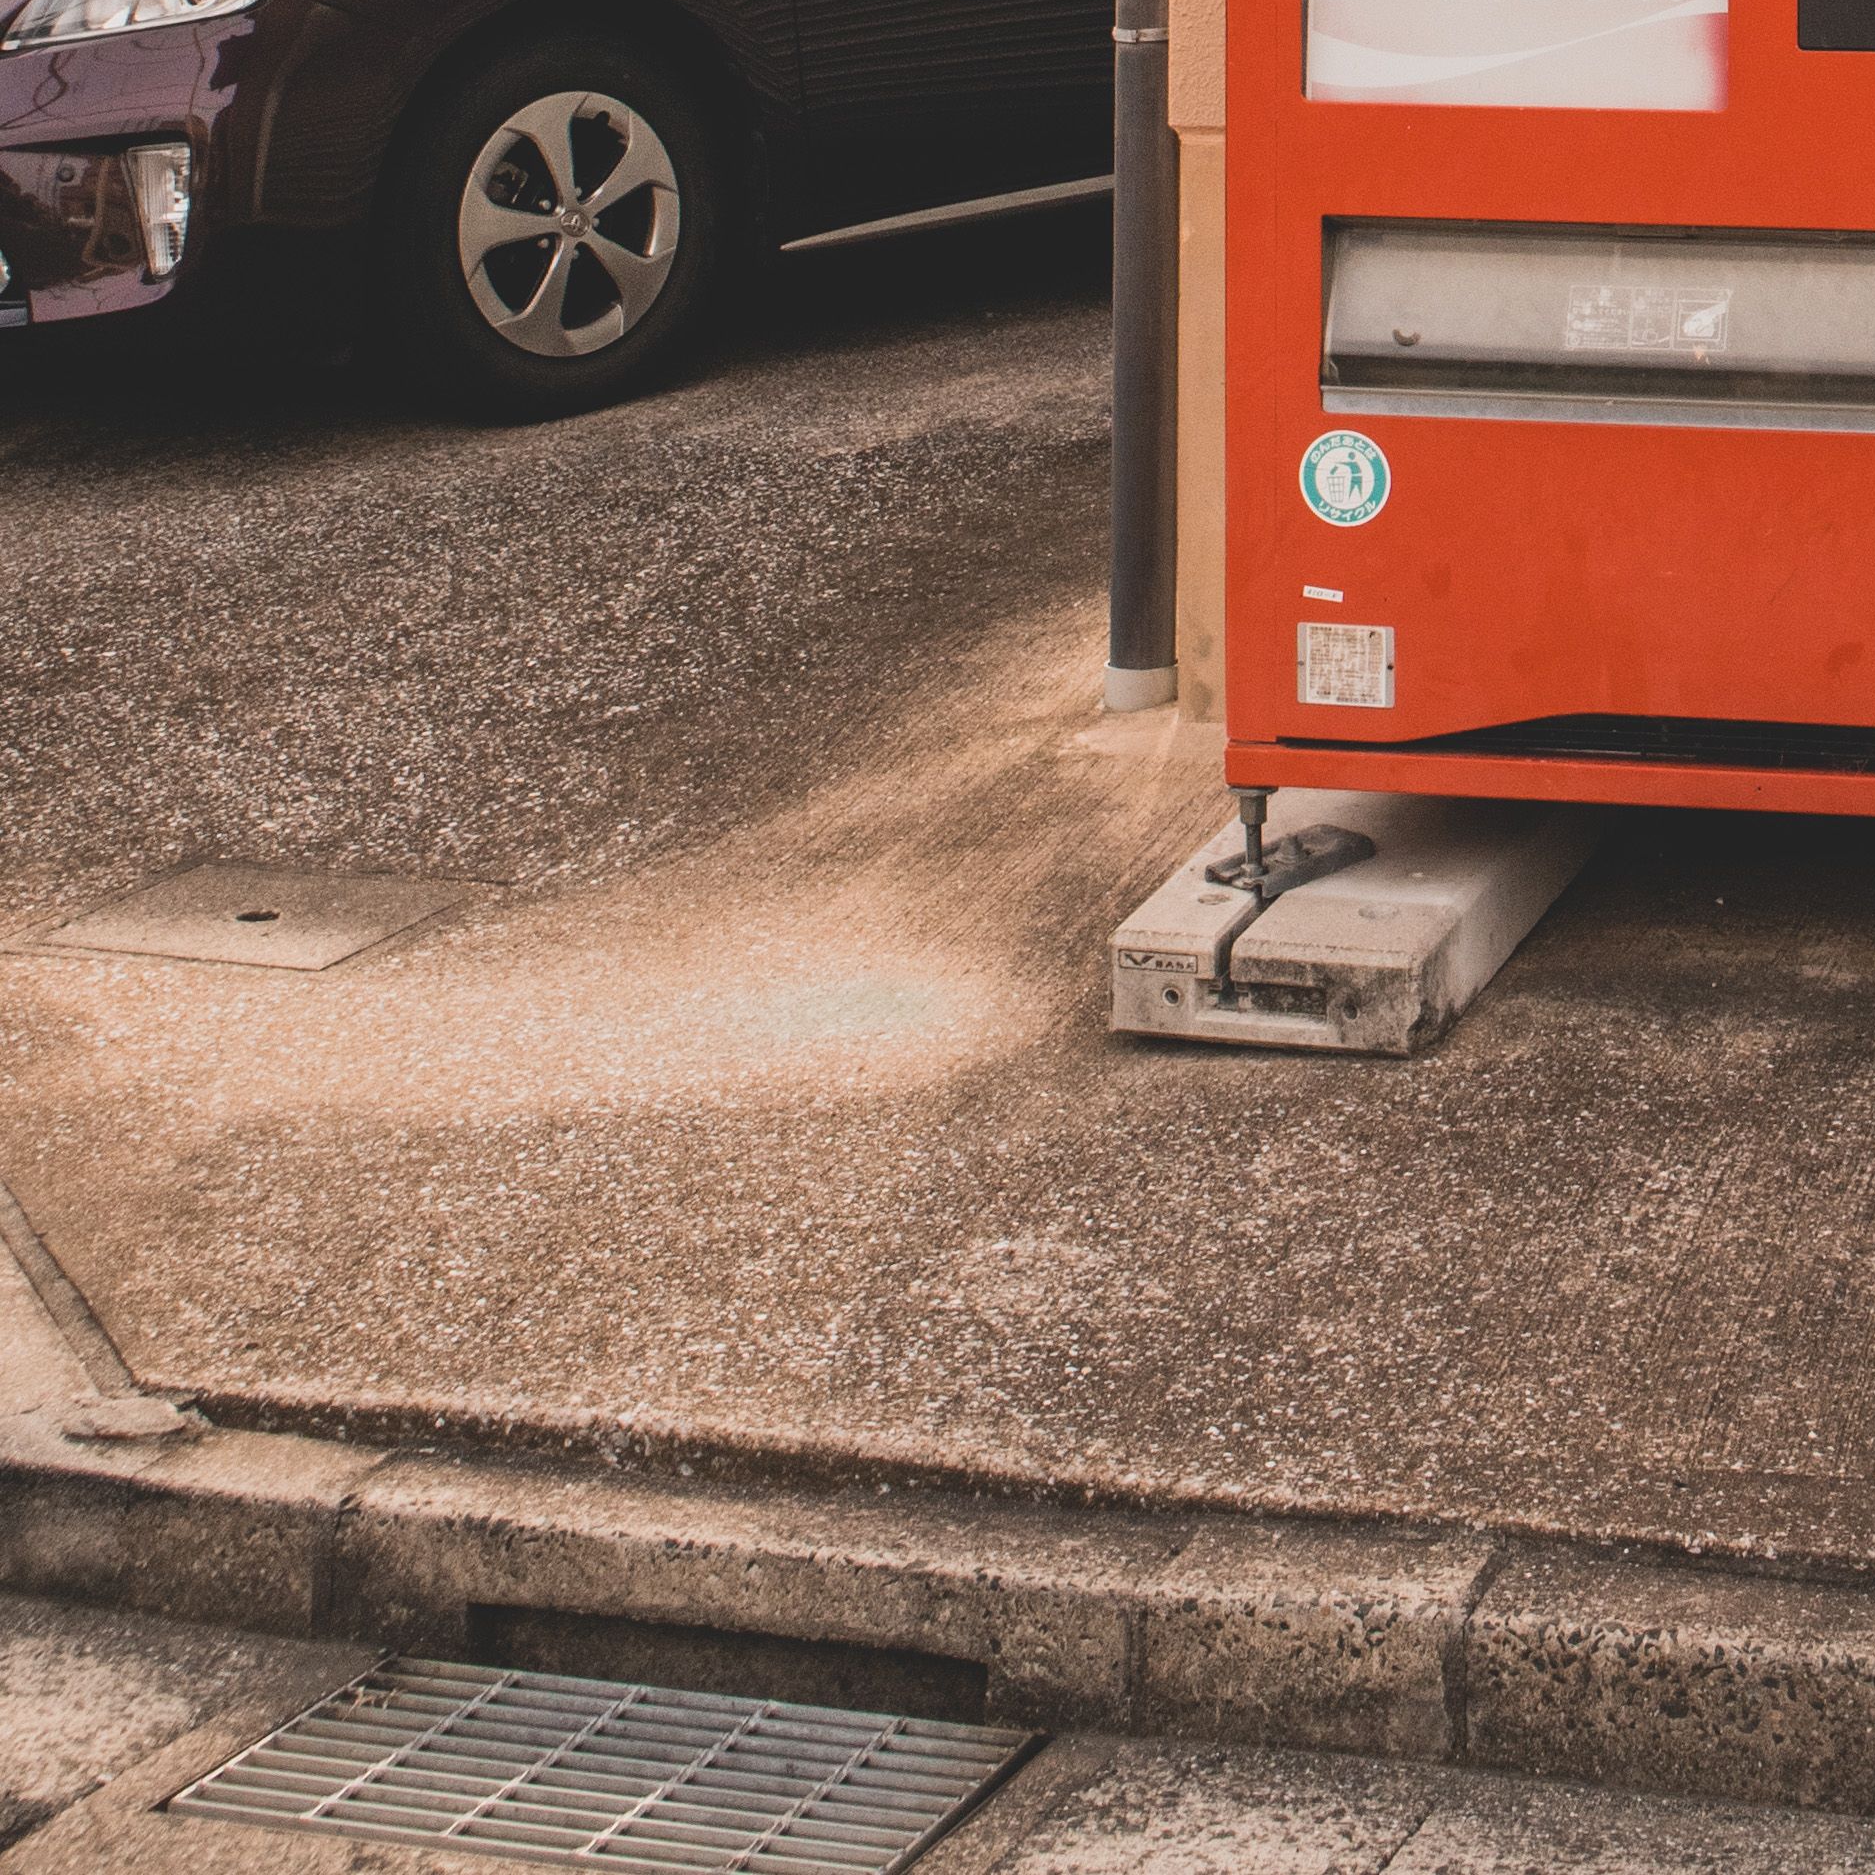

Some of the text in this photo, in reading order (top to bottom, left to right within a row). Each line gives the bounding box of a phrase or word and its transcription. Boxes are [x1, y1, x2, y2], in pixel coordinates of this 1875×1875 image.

[1310, 435, 1377, 464] のんだあとは
[1319, 500, 1376, 521] リサイクル
